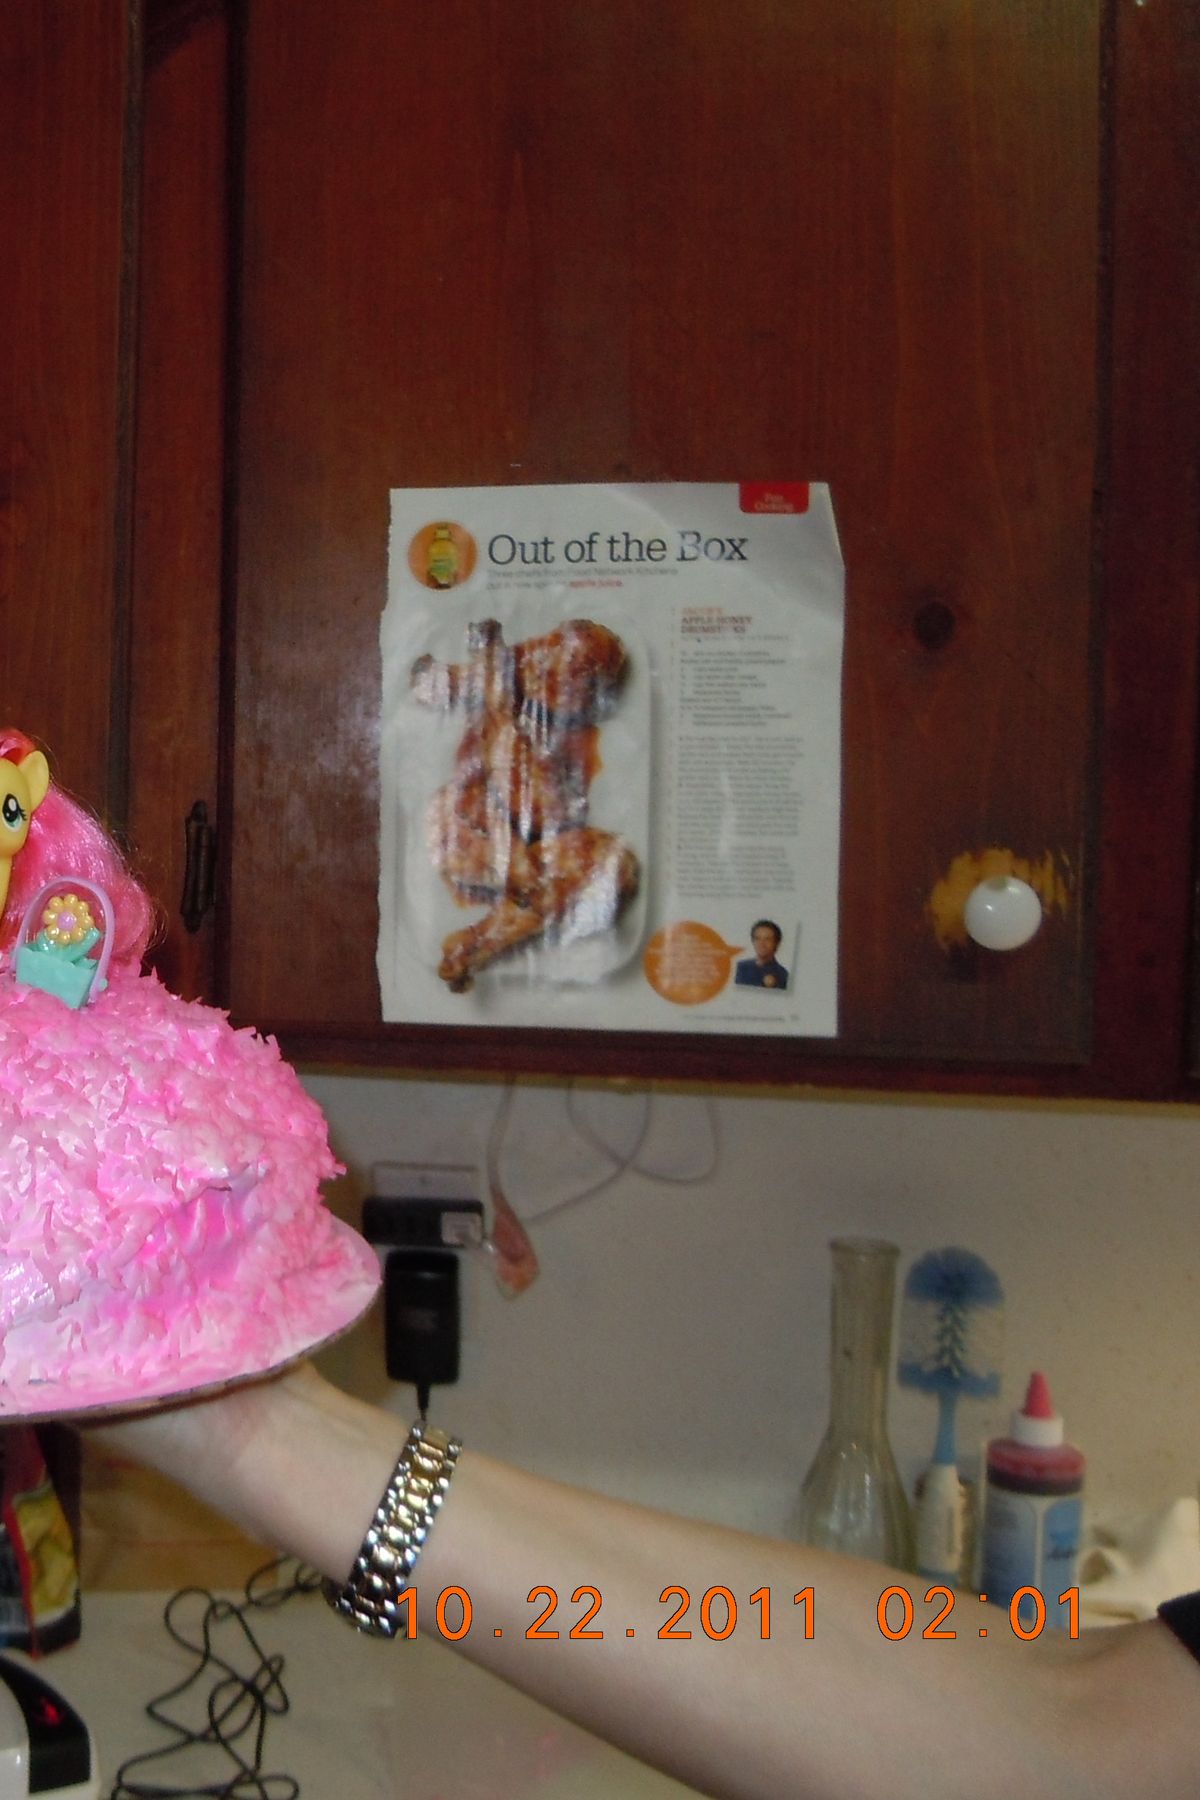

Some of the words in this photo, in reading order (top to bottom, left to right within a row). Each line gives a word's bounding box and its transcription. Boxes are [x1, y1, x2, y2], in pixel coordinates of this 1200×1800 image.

[488, 534, 555, 565] Out
[564, 532, 600, 563] of
[607, 532, 667, 562] the
[675, 531, 748, 562] Box
